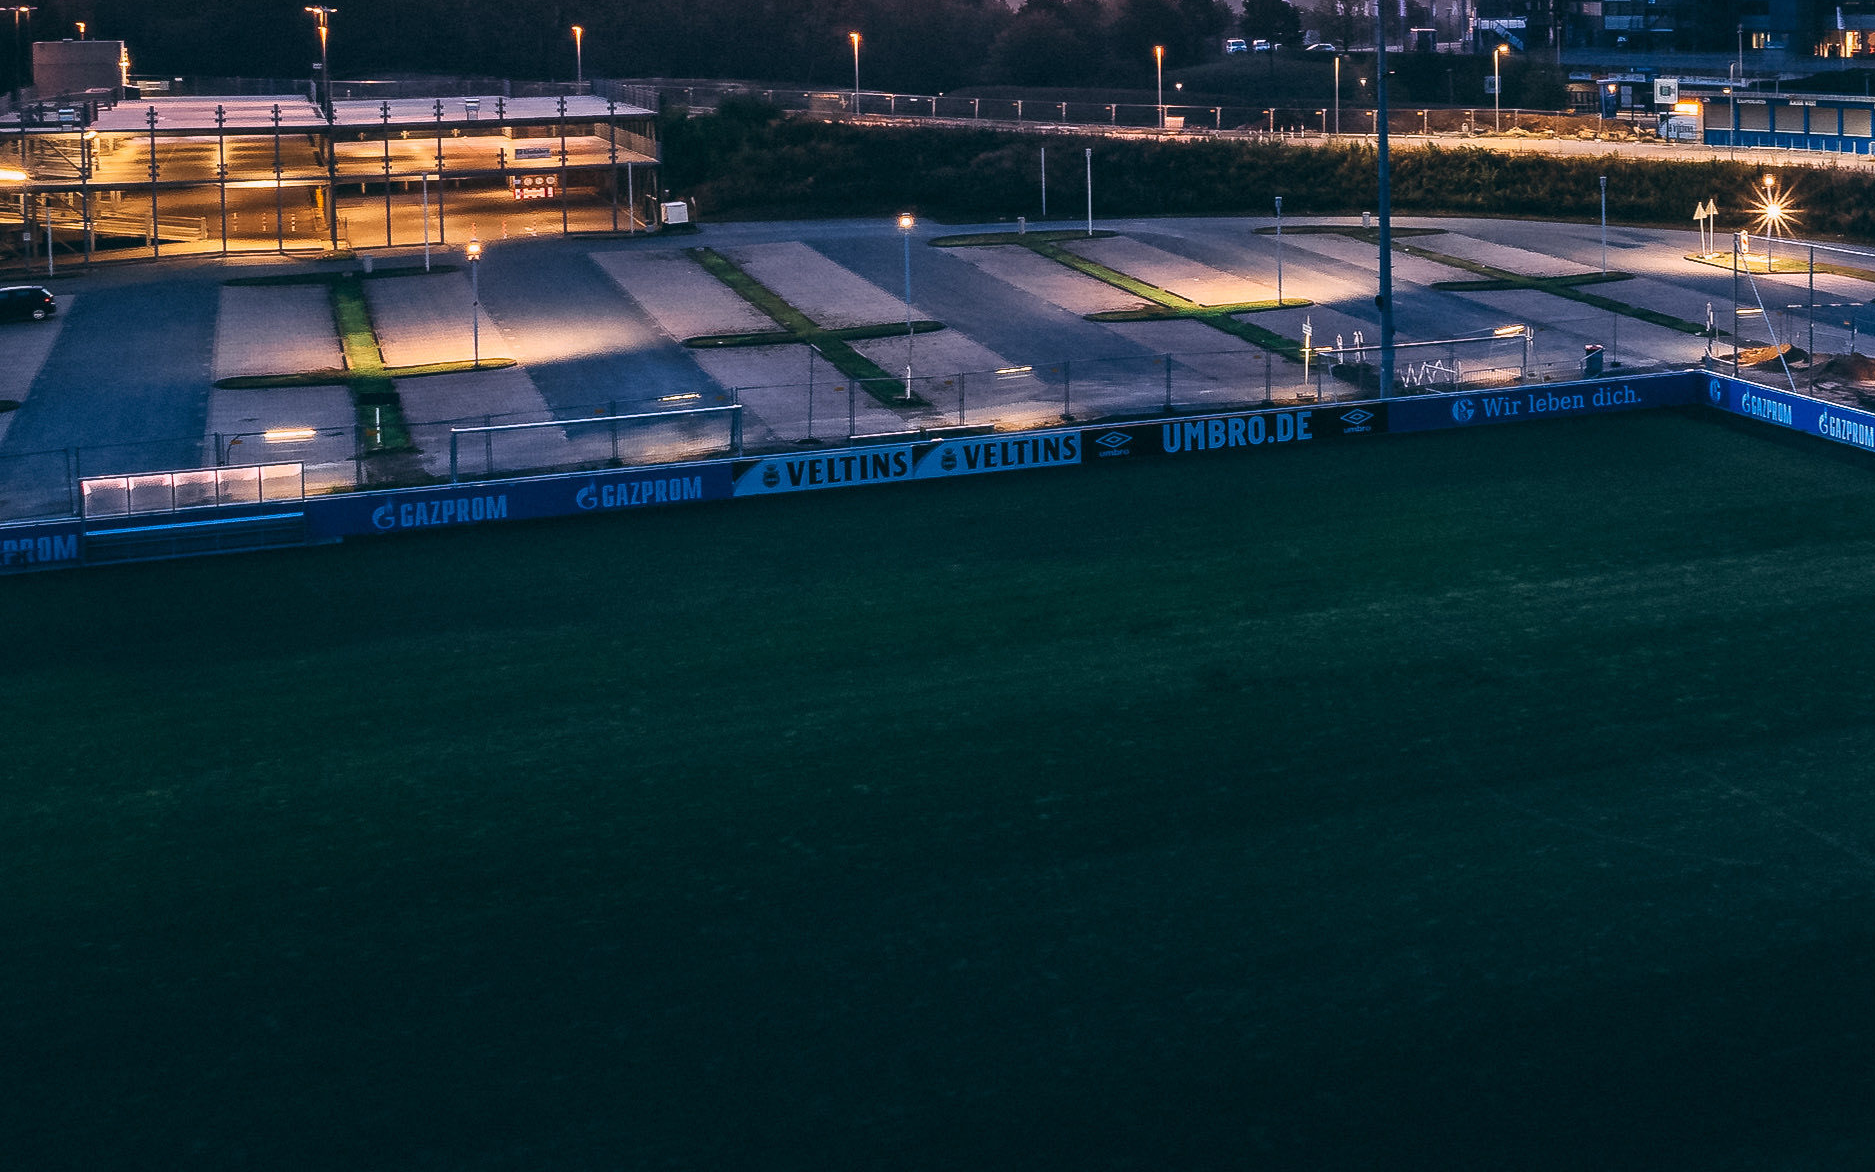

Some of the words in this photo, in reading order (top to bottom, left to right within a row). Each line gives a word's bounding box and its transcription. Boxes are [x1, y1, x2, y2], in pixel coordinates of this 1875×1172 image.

[1482, 397, 1522, 418] Wir
[1528, 392, 1584, 413] leben
[1592, 385, 1642, 407] dich.
[1751, 396, 1793, 425] GAZPROM
[1162, 411, 1312, 453] UMBRO.DE
[1829, 416, 1875, 448] GAZPROM
[786, 441, 907, 486] VELTINS
[963, 435, 1076, 469] VELTINS
[602, 476, 702, 509] GAZPROM
[399, 495, 508, 528] GAZPROM
